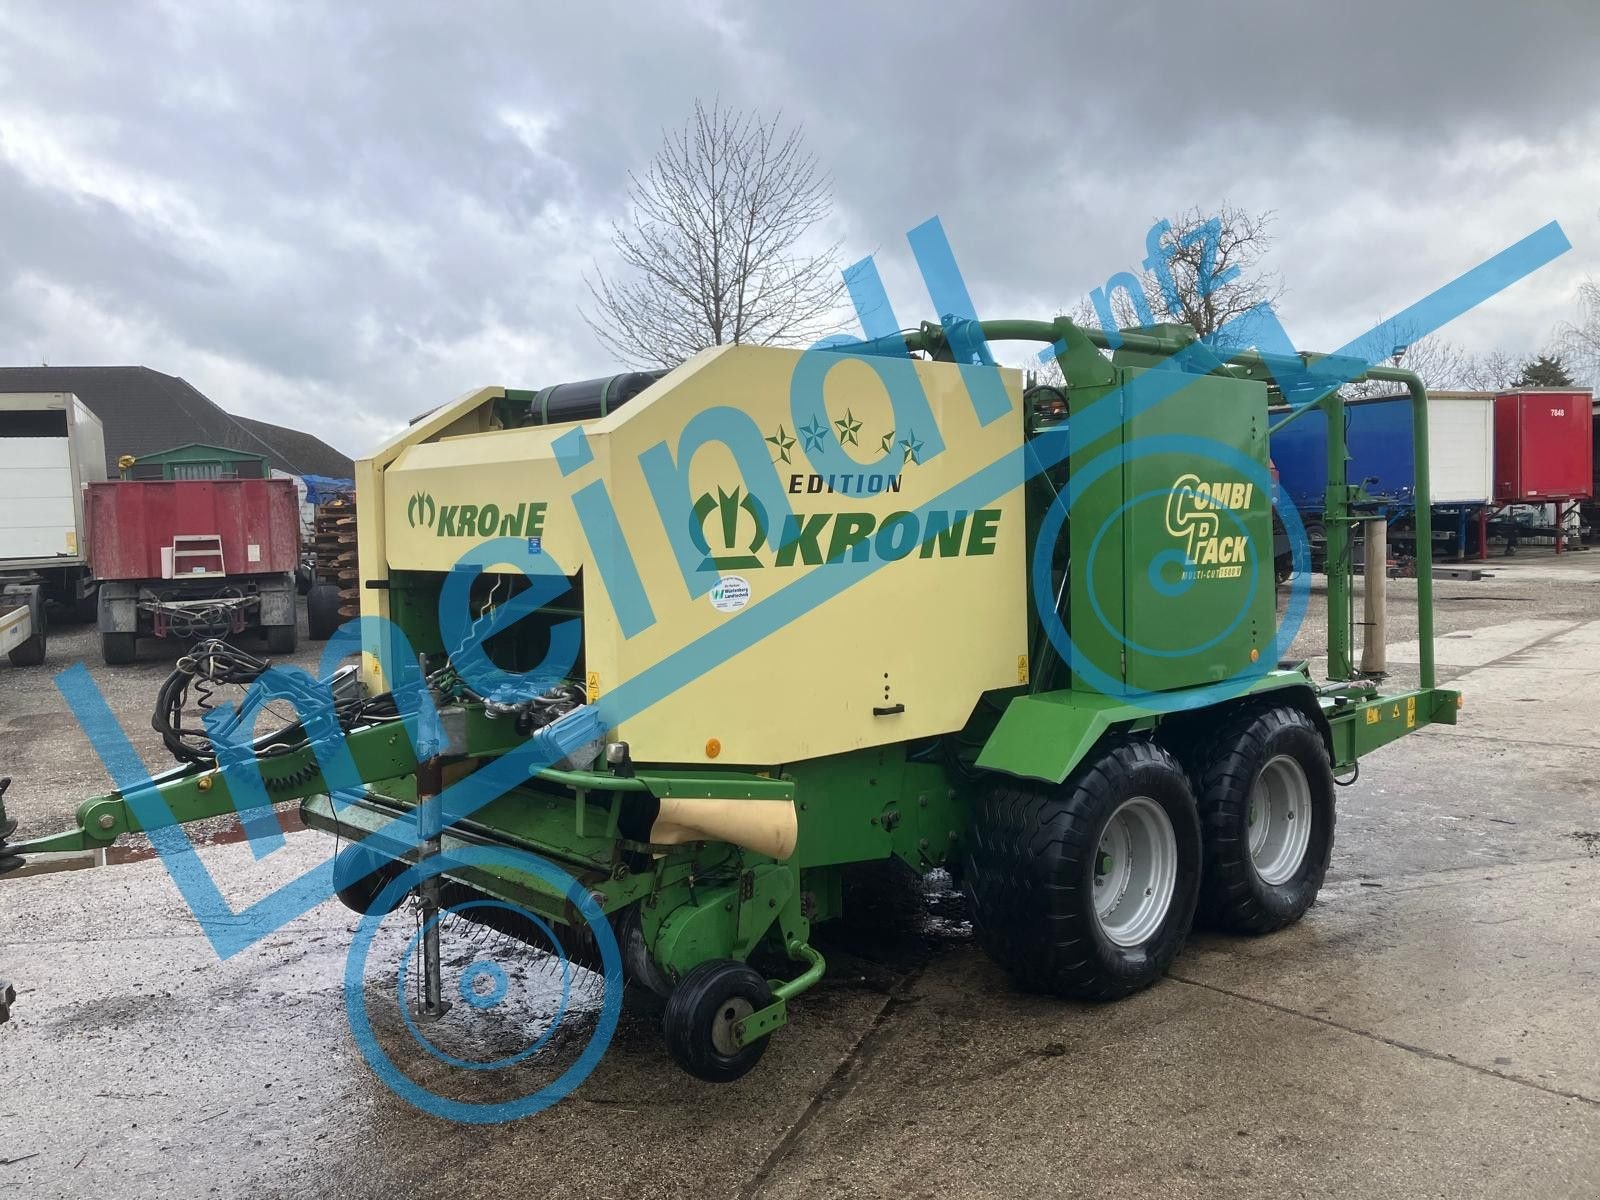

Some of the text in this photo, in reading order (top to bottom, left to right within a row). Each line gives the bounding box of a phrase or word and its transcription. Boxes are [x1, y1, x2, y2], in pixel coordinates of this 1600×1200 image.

[788, 474, 902, 494] EDITION
[1166, 474, 1254, 537] COMBI
[436, 502, 548, 537] KRONE
[774, 509, 1002, 567] KRONE
